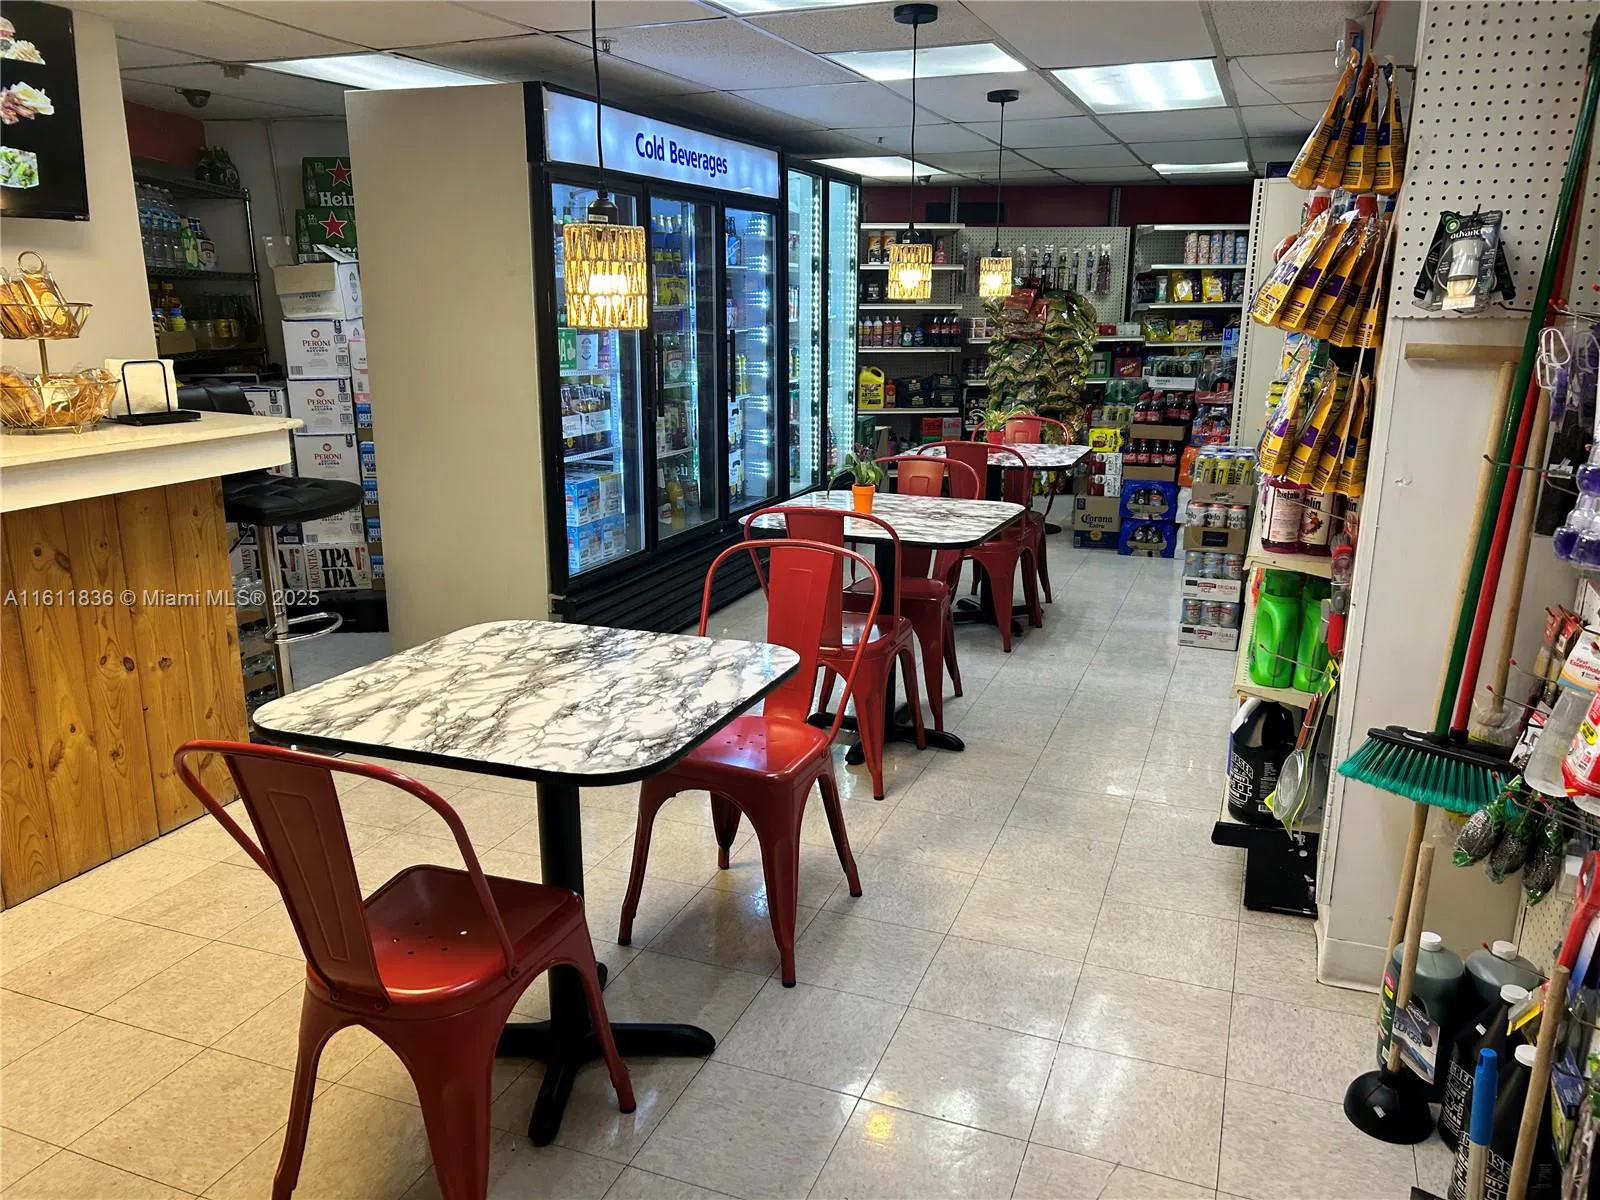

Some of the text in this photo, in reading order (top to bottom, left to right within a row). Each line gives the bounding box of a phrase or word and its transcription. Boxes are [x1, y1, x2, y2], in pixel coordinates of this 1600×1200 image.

[635, 132, 728, 178] Cold Beverages
[314, 453, 343, 461] PERONI
[1081, 513, 1113, 523] Corona
[319, 548, 354, 568] IPA
[322, 568, 357, 589] IPA
